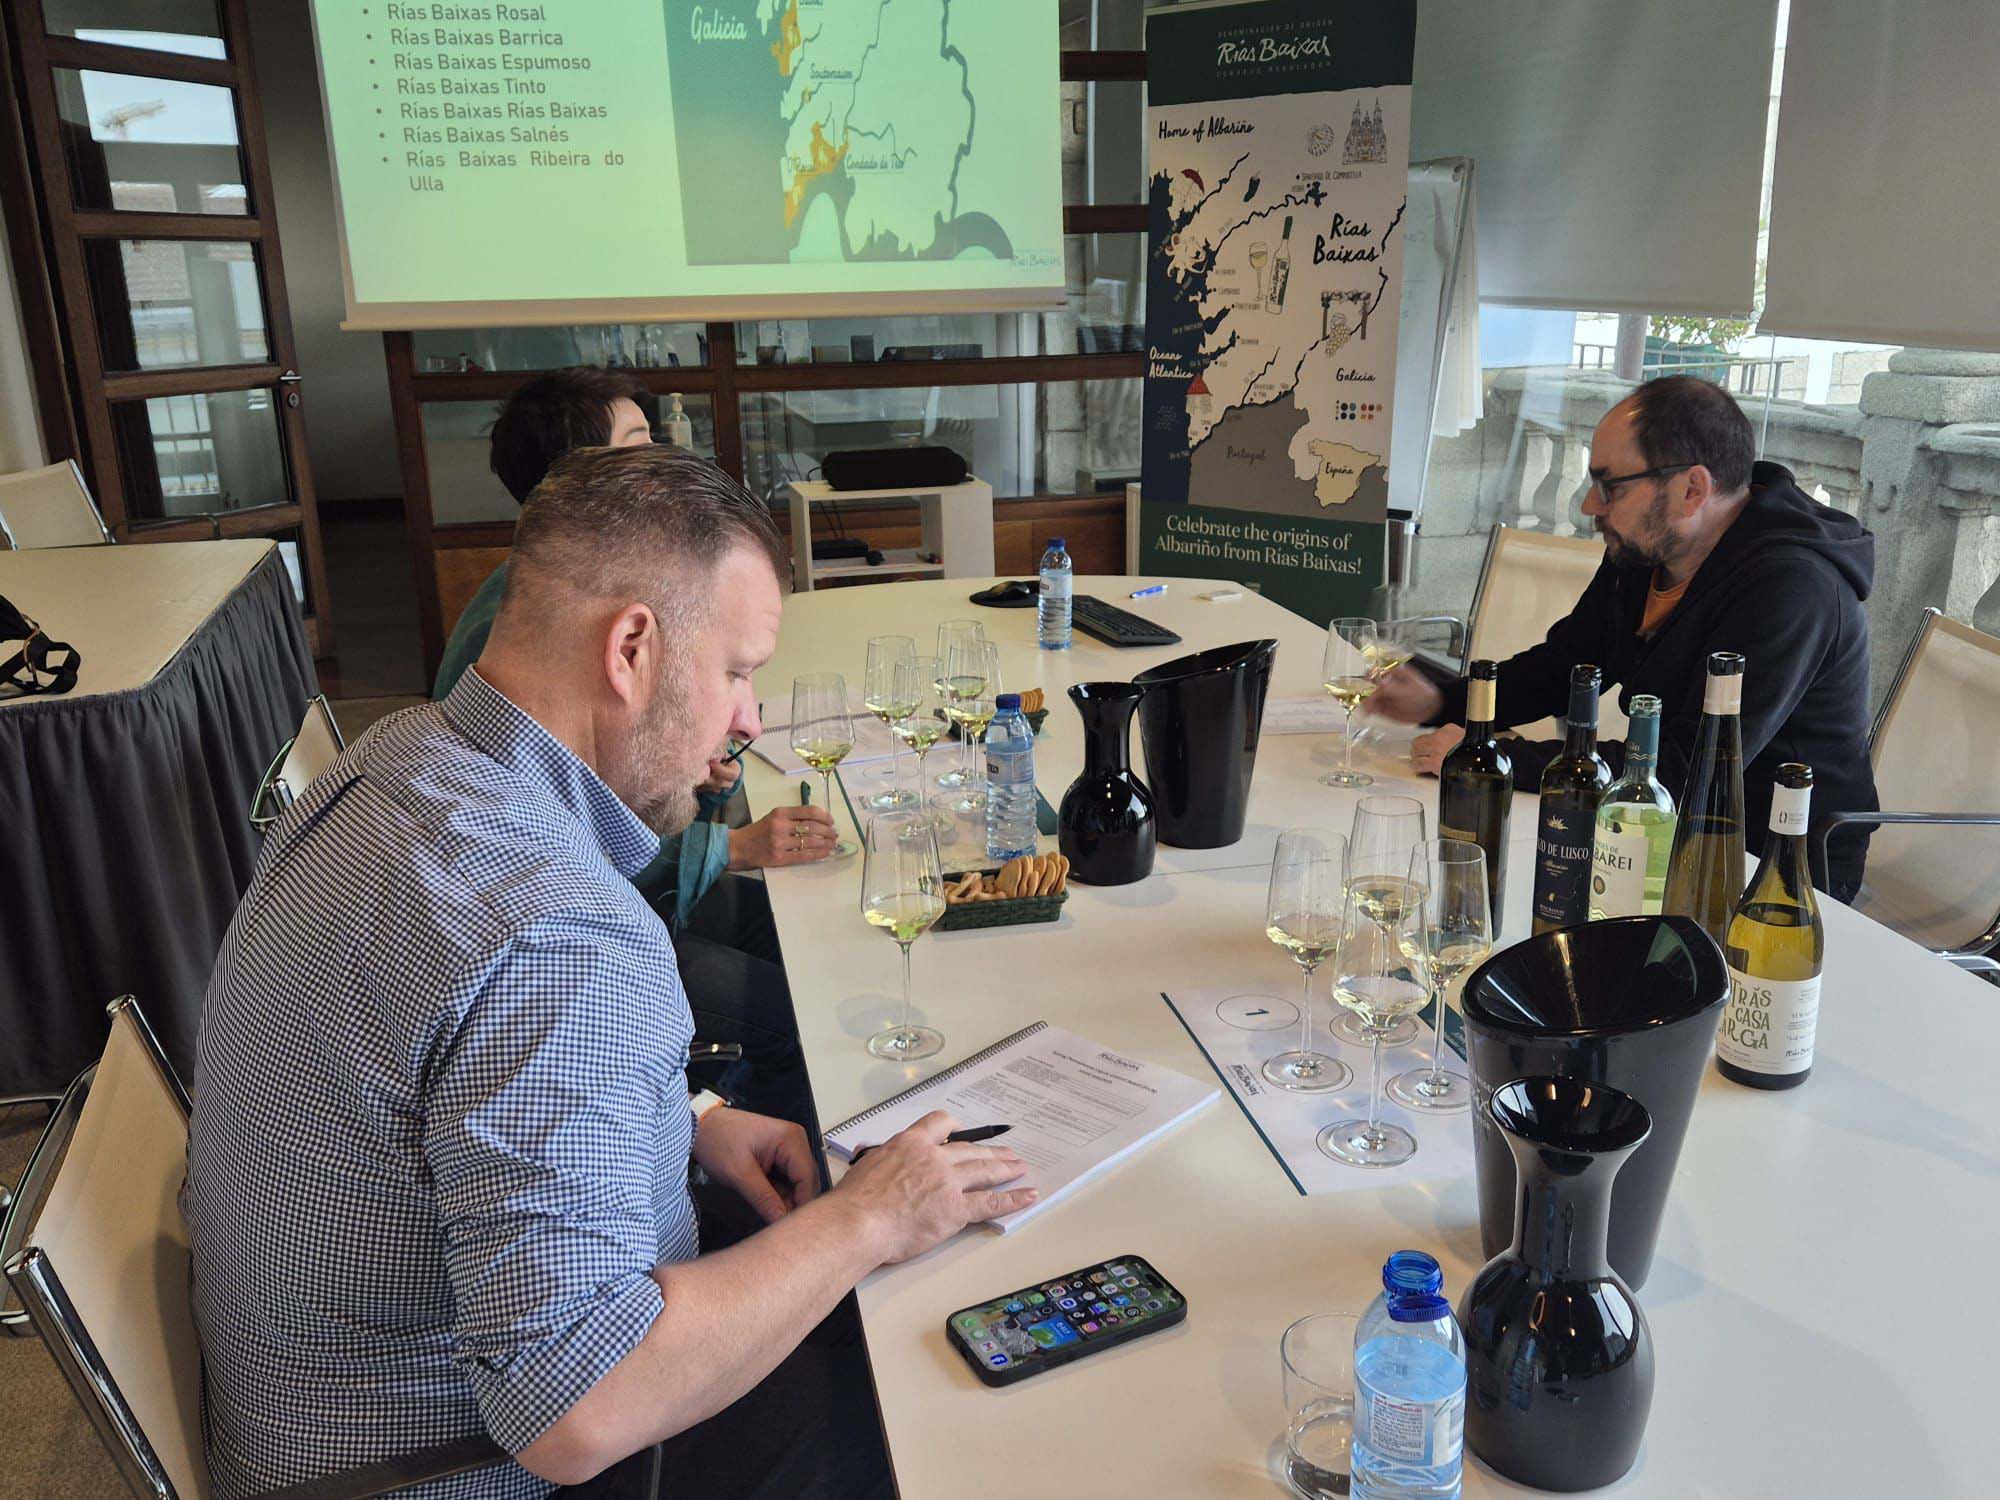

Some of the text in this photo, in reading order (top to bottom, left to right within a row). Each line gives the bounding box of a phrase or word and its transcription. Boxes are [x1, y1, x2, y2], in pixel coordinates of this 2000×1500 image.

[387, 2, 546, 21] Rías Baixas Rosal
[691, 5, 748, 44] Galicia
[391, 28, 563, 46] Rías Baixas Barrica
[1259, 35, 1331, 62] Baixas
[394, 53, 591, 72] Rías Baixas Espumoso
[397, 77, 546, 94] Rías Baixas Tinto
[401, 101, 607, 119] Rías Baixas Rías Baixas
[404, 125, 569, 143] Rías Baixas Salnés
[1158, 120, 1190, 139] Home
[1192, 120, 1205, 143] of
[407, 150, 624, 167] Rías Baixas Ribeira do
[410, 176, 444, 191] Ulla
[1330, 213, 1371, 239] Rías
[1313, 234, 1379, 265] Baixas
[1335, 367, 1376, 383] Galicia
[1166, 514, 1352, 552] Celebrate the origins of
[1155, 535, 1220, 558] Albariño
[1223, 541, 1261, 563] from
[1303, 551, 1362, 575] Baixas!
[1547, 842, 1559, 856] DE
[1560, 845, 1590, 860] LUSCO
[1594, 847, 1632, 871] BAREI
[1735, 1007, 1770, 1031] CASA
